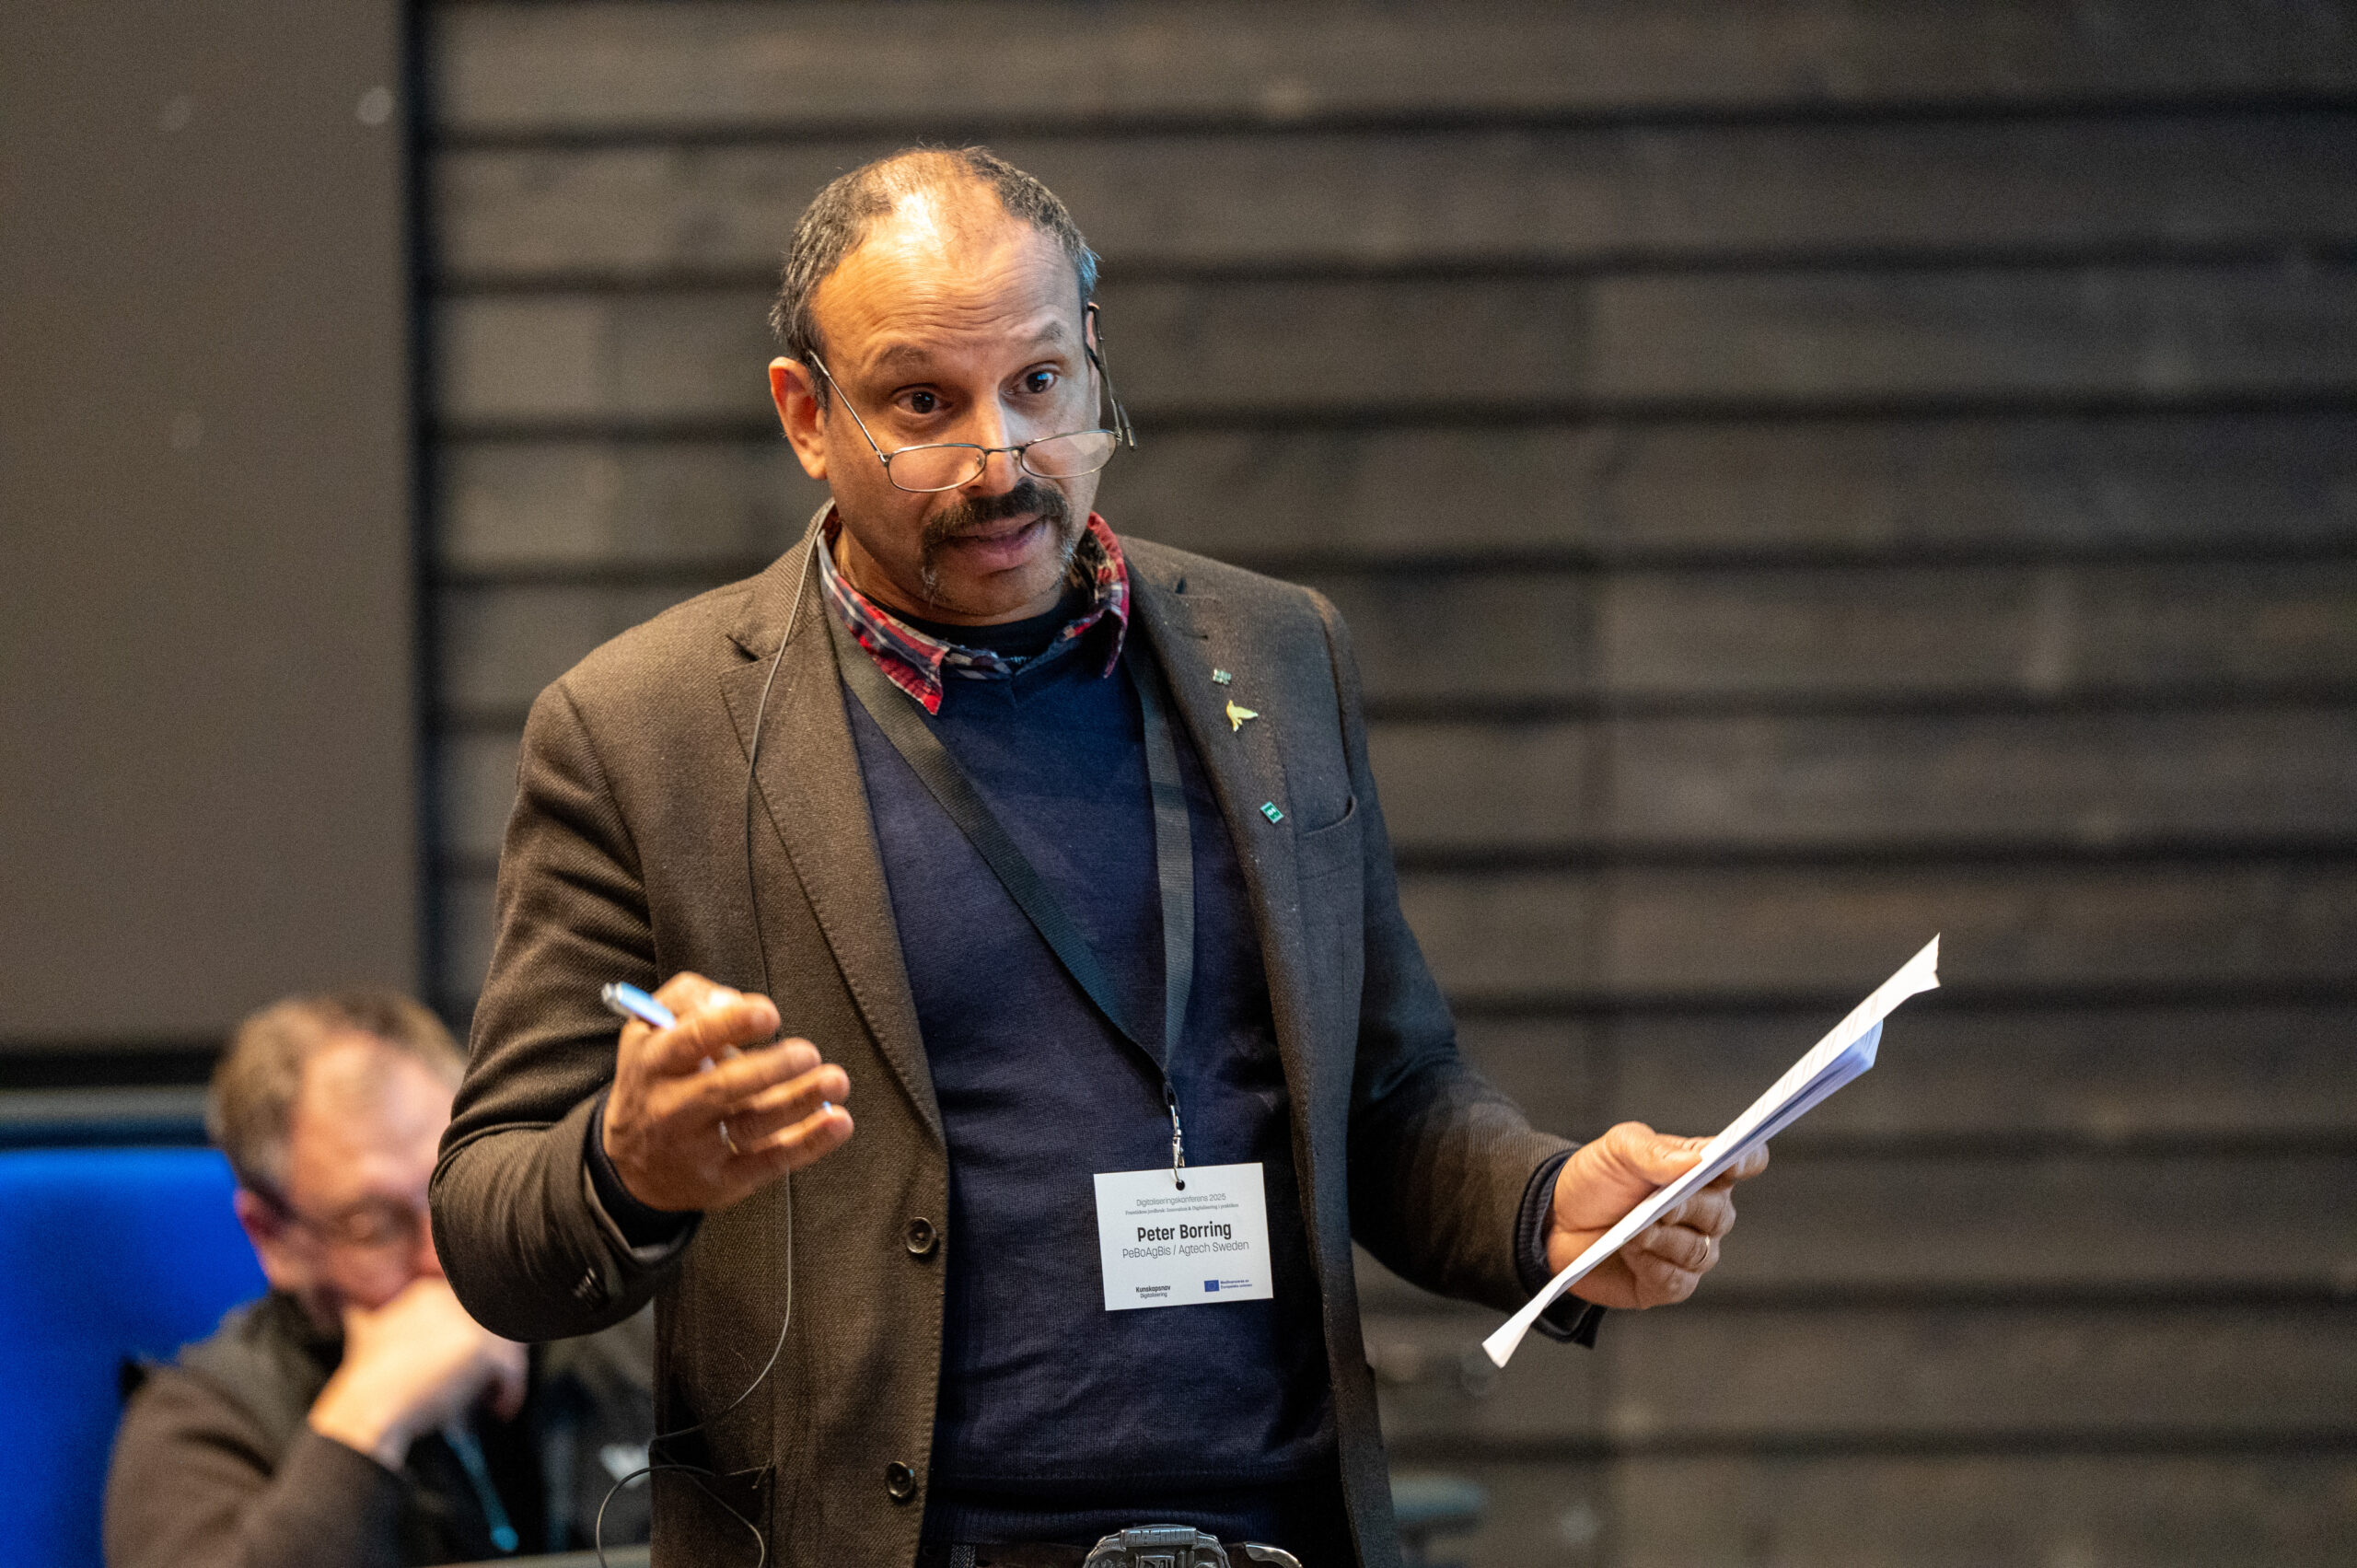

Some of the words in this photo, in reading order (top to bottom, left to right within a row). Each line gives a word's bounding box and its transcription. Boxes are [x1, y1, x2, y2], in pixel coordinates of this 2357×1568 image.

[1136, 1195, 1208, 1208] Digitaliseringskonferens
[1209, 1193, 1226, 1202] 2025
[1137, 1226, 1175, 1242] Peter
[1179, 1221, 1232, 1240] Borring
[1123, 1246, 1171, 1259] PeBoAgBis
[1173, 1245, 1177, 1256] /
[1178, 1242, 1211, 1256] Agtech
[1213, 1240, 1249, 1252] Sweden
[1135, 1284, 1171, 1294] Kunskapsnav
